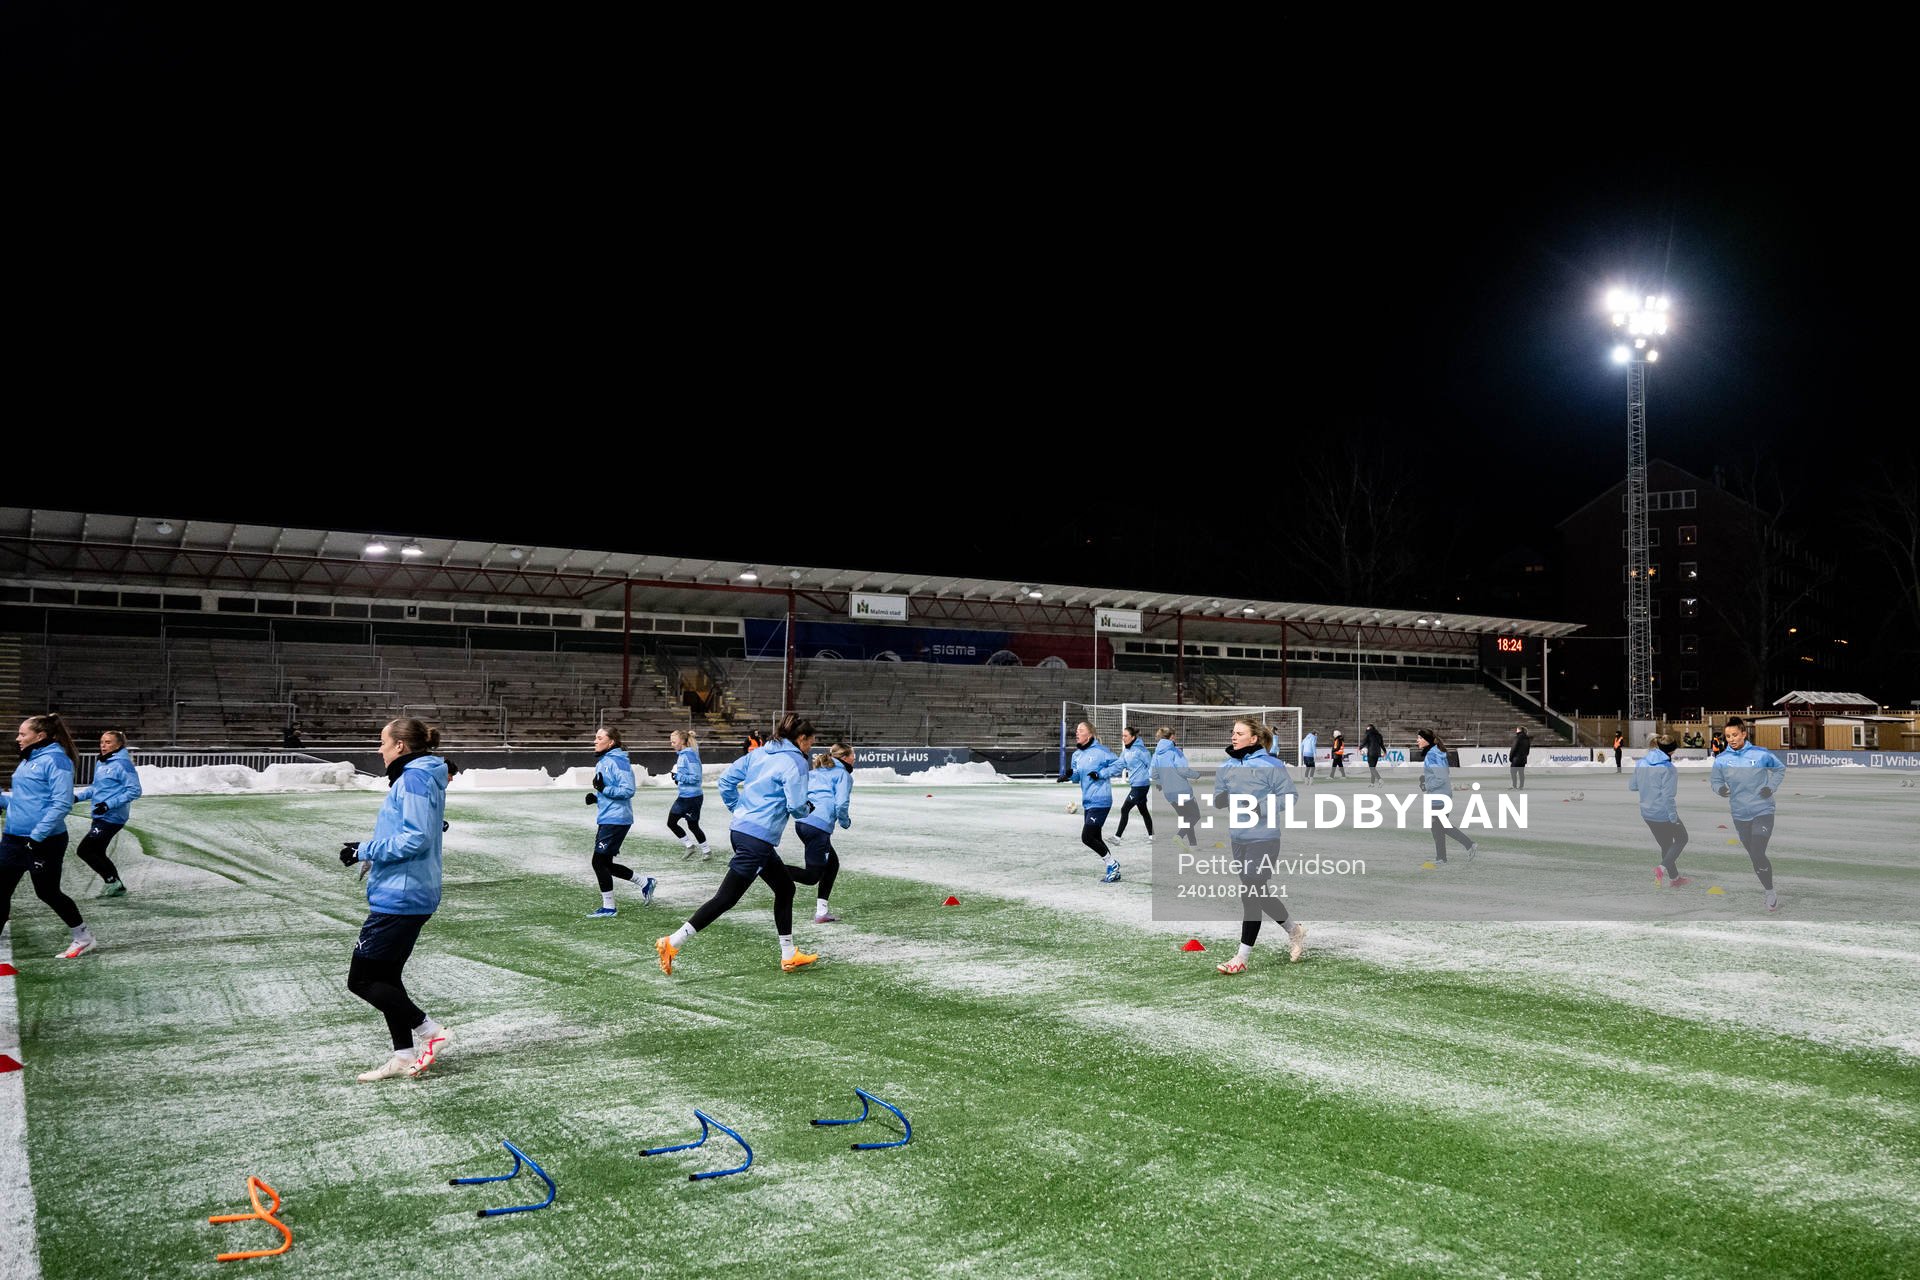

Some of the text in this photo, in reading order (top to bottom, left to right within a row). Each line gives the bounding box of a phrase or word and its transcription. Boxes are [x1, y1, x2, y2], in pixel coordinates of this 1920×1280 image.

[1497, 638, 1523, 652] 18:24
[858, 751, 894, 762] MÖTEN
[902, 750, 929, 762] ÅHUS
[1549, 754, 1589, 762] Handelsbanken
[1800, 753, 1854, 766] Wihlborgs
